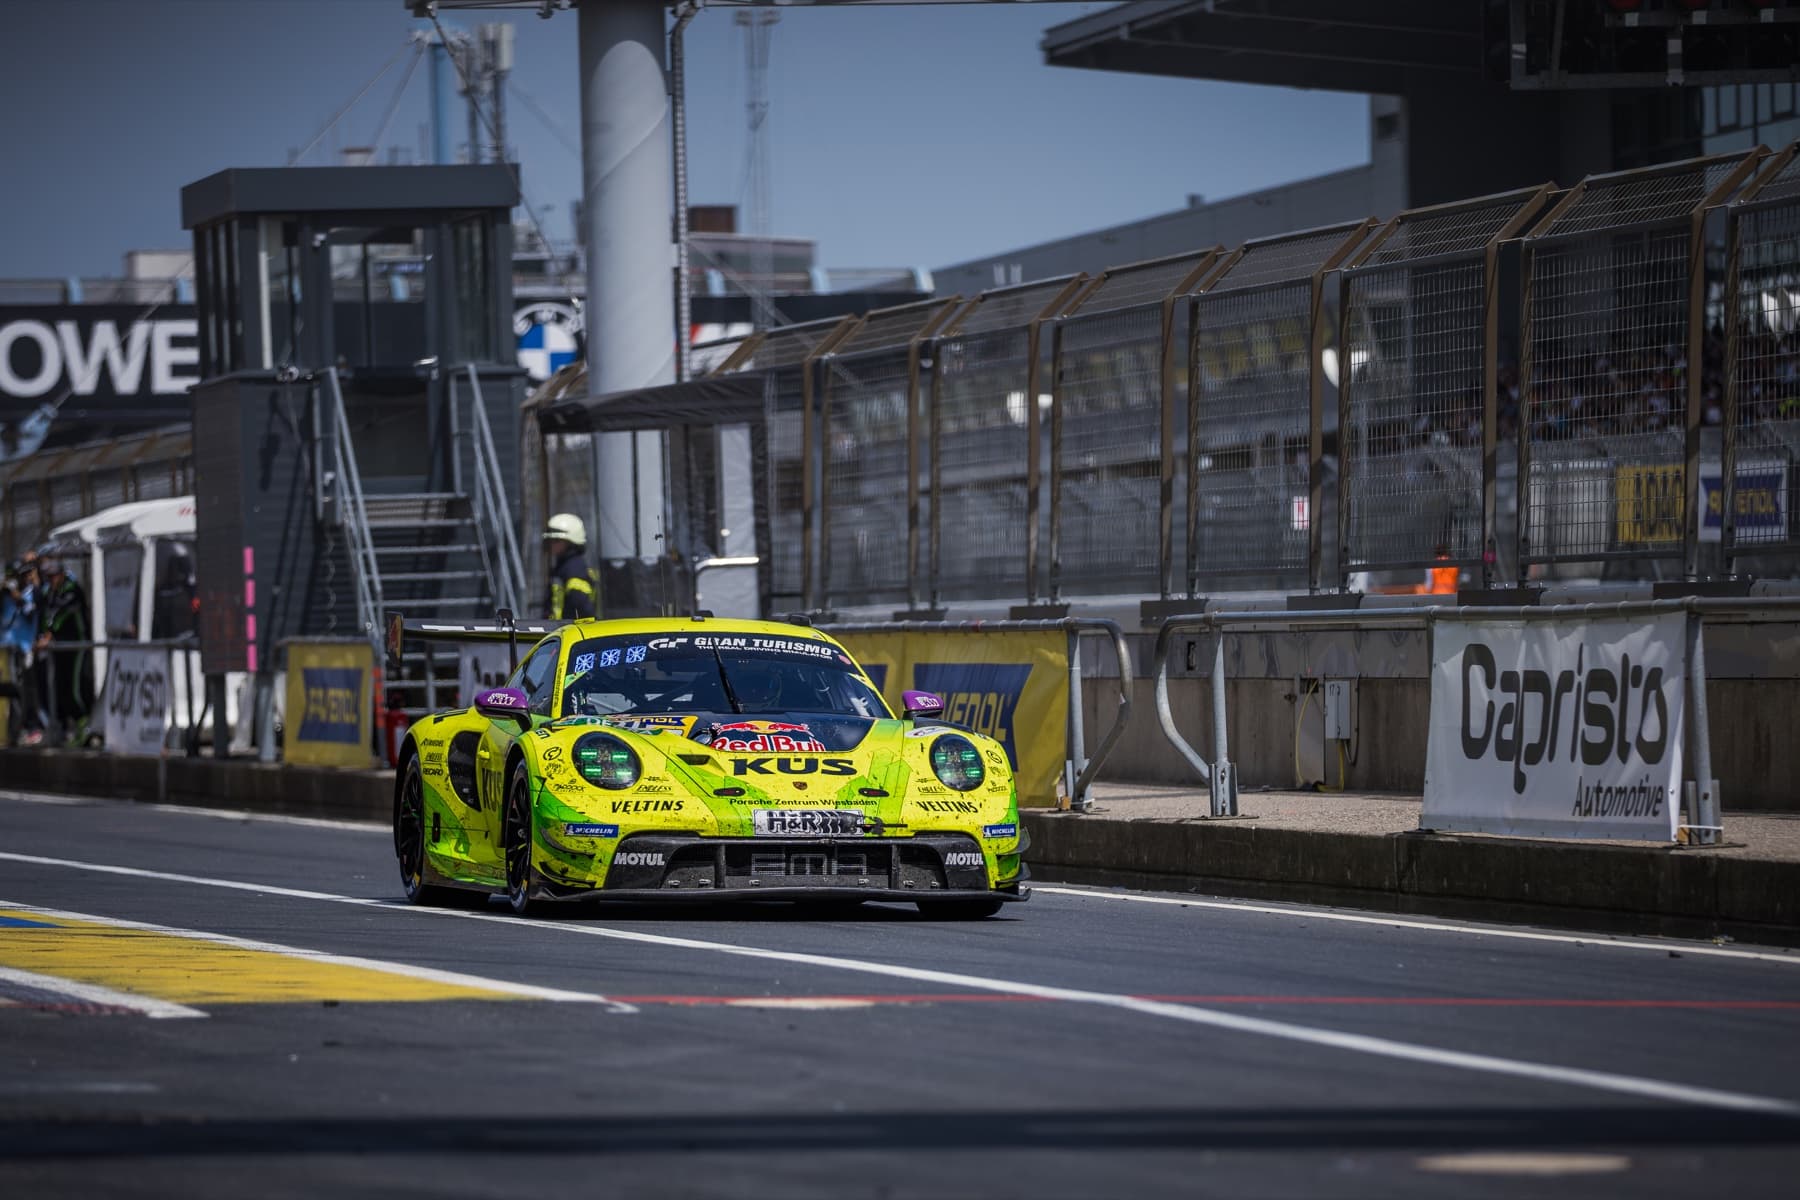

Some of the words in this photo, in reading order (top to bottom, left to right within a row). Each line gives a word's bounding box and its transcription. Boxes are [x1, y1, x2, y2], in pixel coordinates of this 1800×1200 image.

[695, 637, 746, 646] GRAN
[752, 638, 832, 656] TURISMO
[936, 691, 1008, 742] VENOL
[1461, 642, 1668, 795] Capristo
[729, 757, 858, 776] KÜS
[1572, 773, 1664, 817] Automotive
[611, 800, 685, 815] VELTINS
[916, 800, 979, 814] VELTINS
[574, 827, 614, 835] MICHELIN
[613, 852, 666, 866] MOTUL
[945, 852, 984, 867] MOTUL
